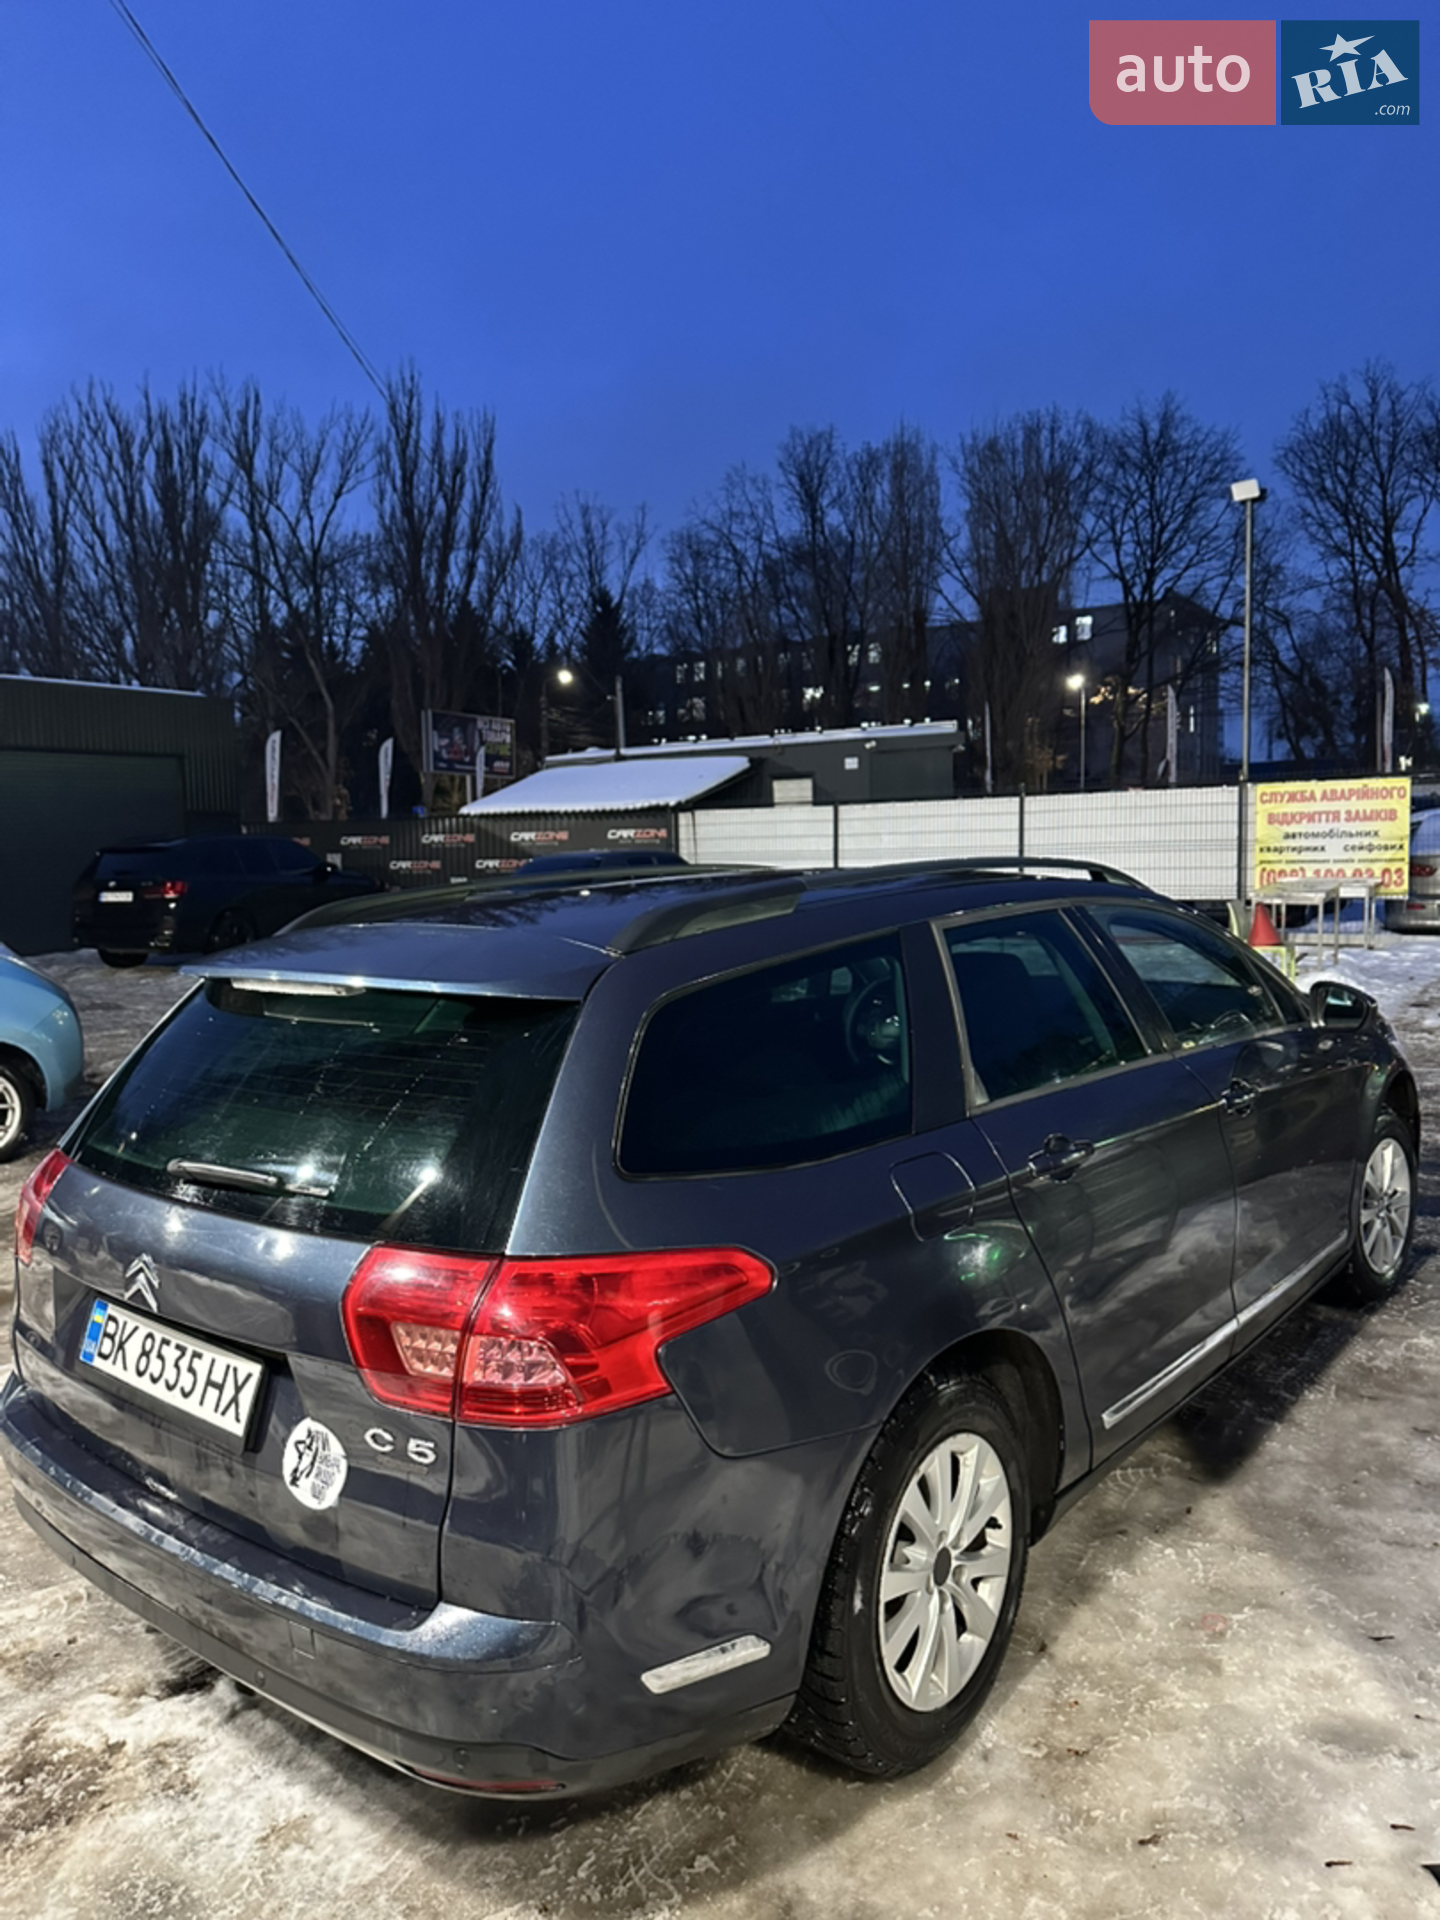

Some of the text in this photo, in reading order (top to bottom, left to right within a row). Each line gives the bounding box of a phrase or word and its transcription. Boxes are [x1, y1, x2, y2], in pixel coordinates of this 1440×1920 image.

[1259, 785, 1407, 804] СЛУЖБА АВАРІЙНОГО
[1267, 808, 1398, 826] ВІДКРИТТЯ ЗАМКІВ
[1283, 827, 1380, 840] автомобільних
[1259, 841, 1405, 855] квартирних сейфових
[97, 1314, 253, 1423] BK 8535 HX
